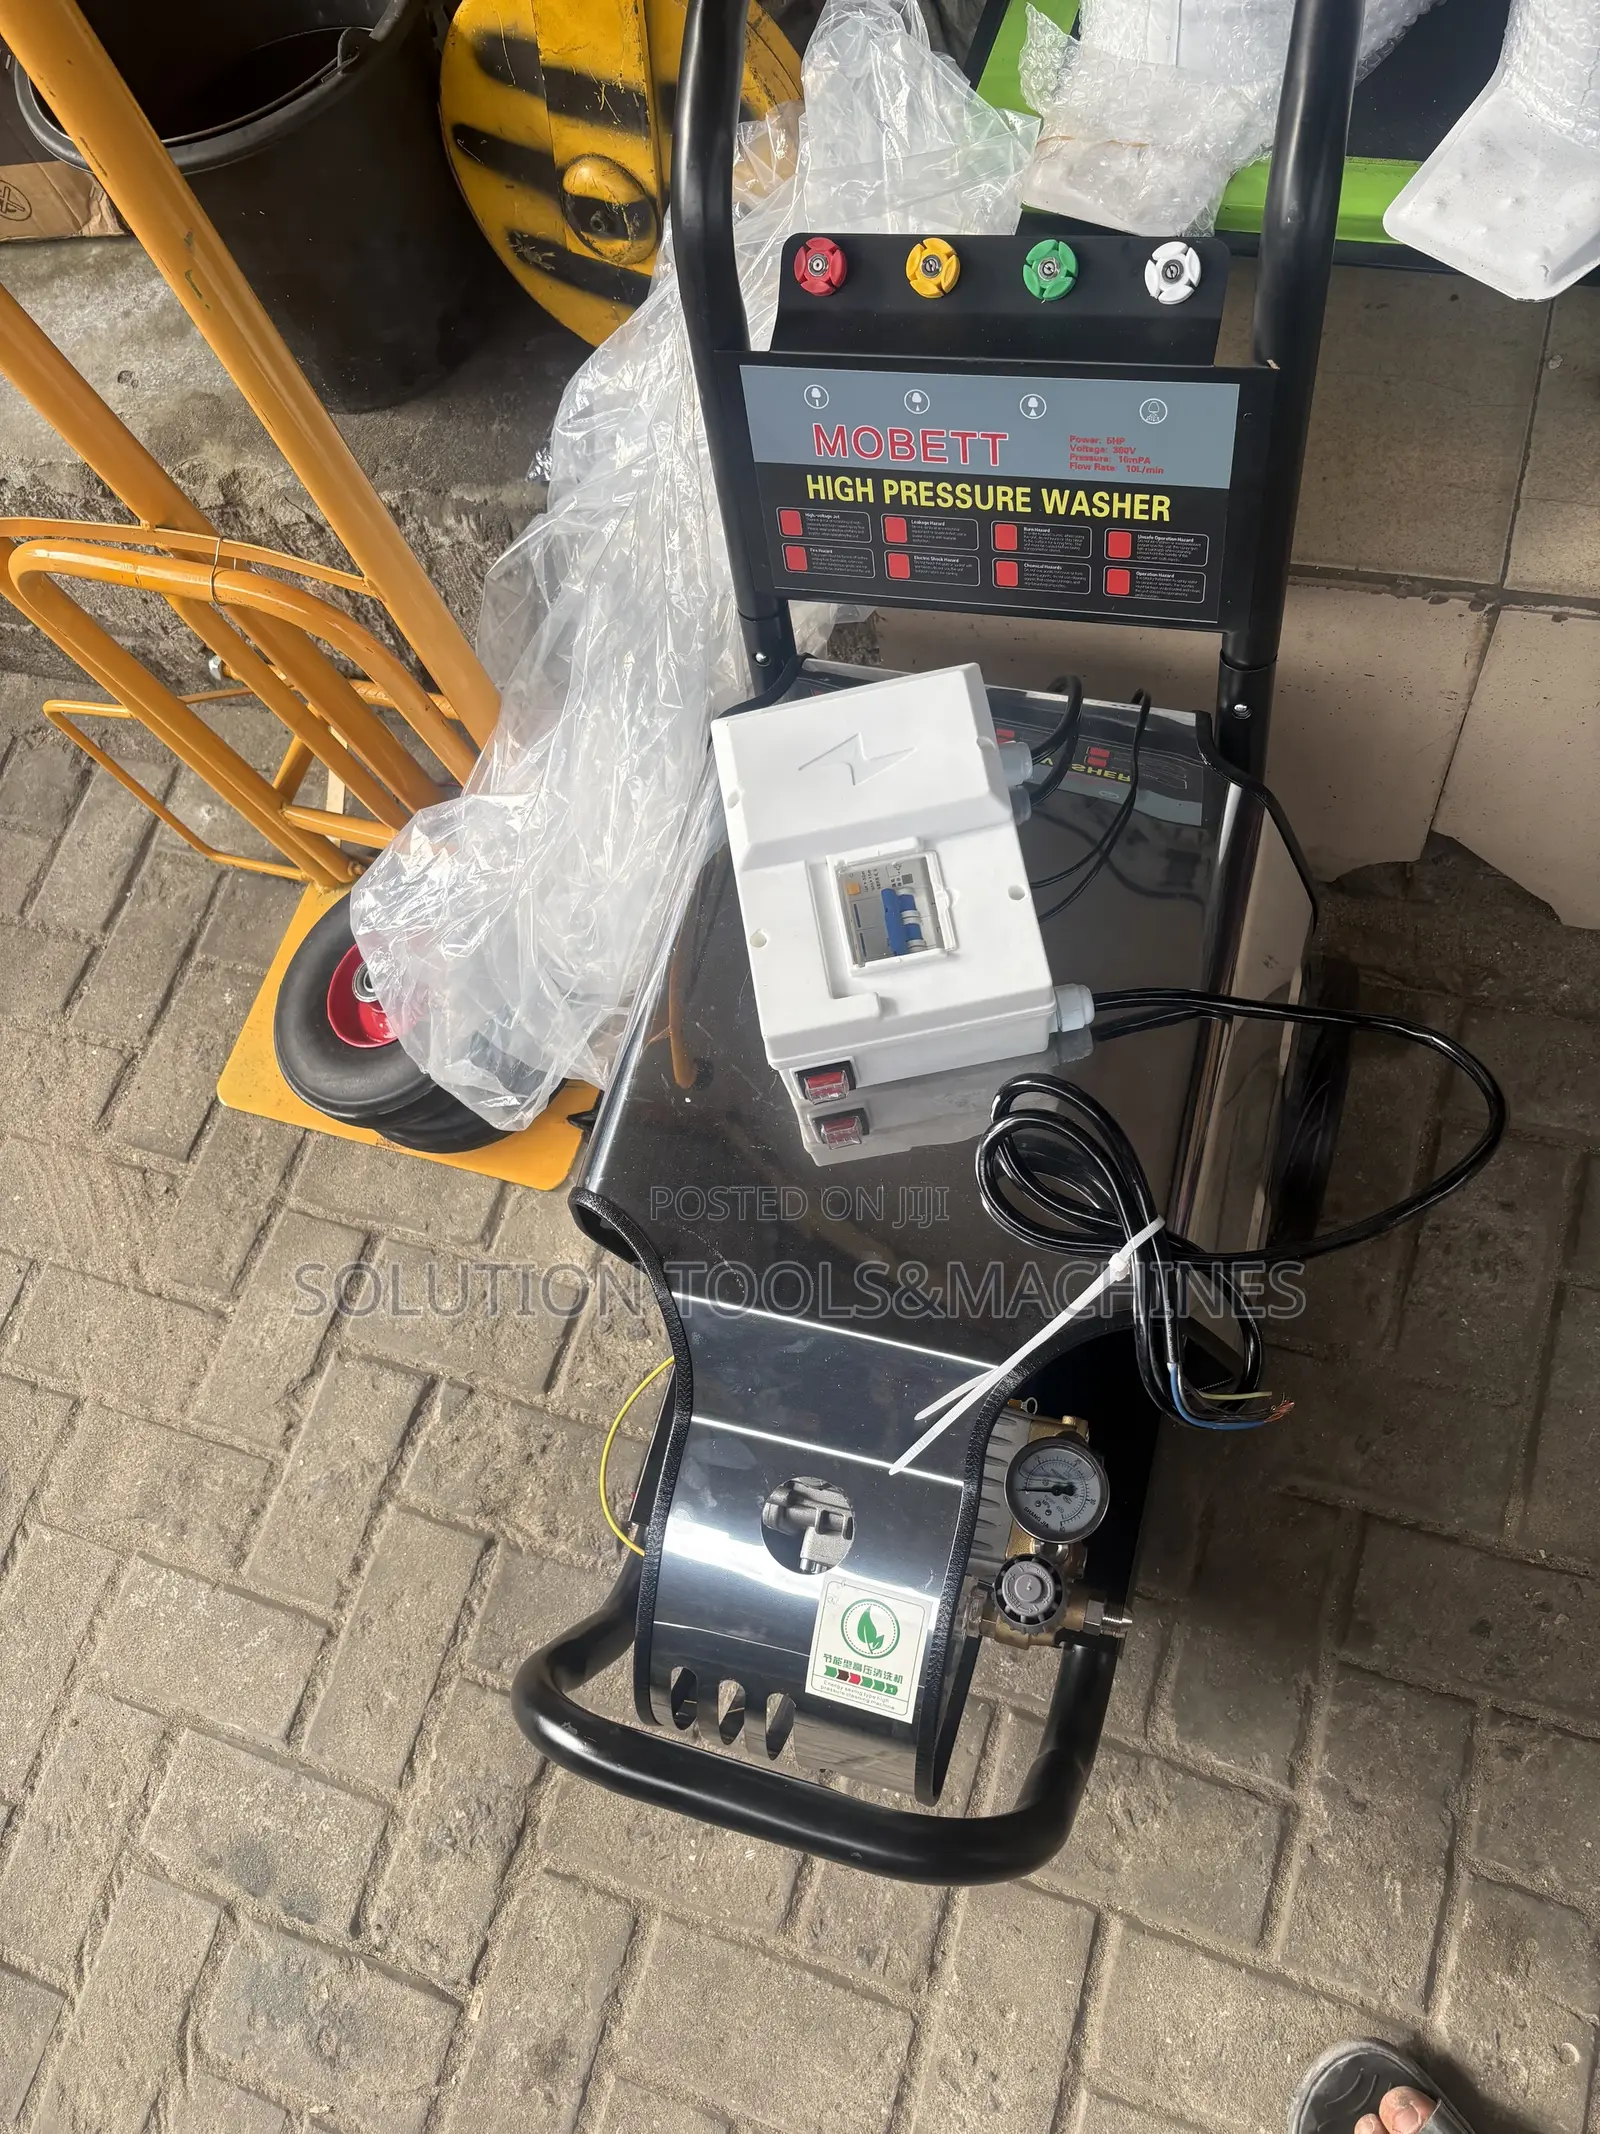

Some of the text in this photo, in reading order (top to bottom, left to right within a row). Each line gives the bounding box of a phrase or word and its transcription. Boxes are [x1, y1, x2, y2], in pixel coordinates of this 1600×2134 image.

[813, 423, 1008, 466] MOBETT
[1069, 462, 1092, 471] Flow
[806, 475, 1171, 522] HIGH PRESSURE WASHER
